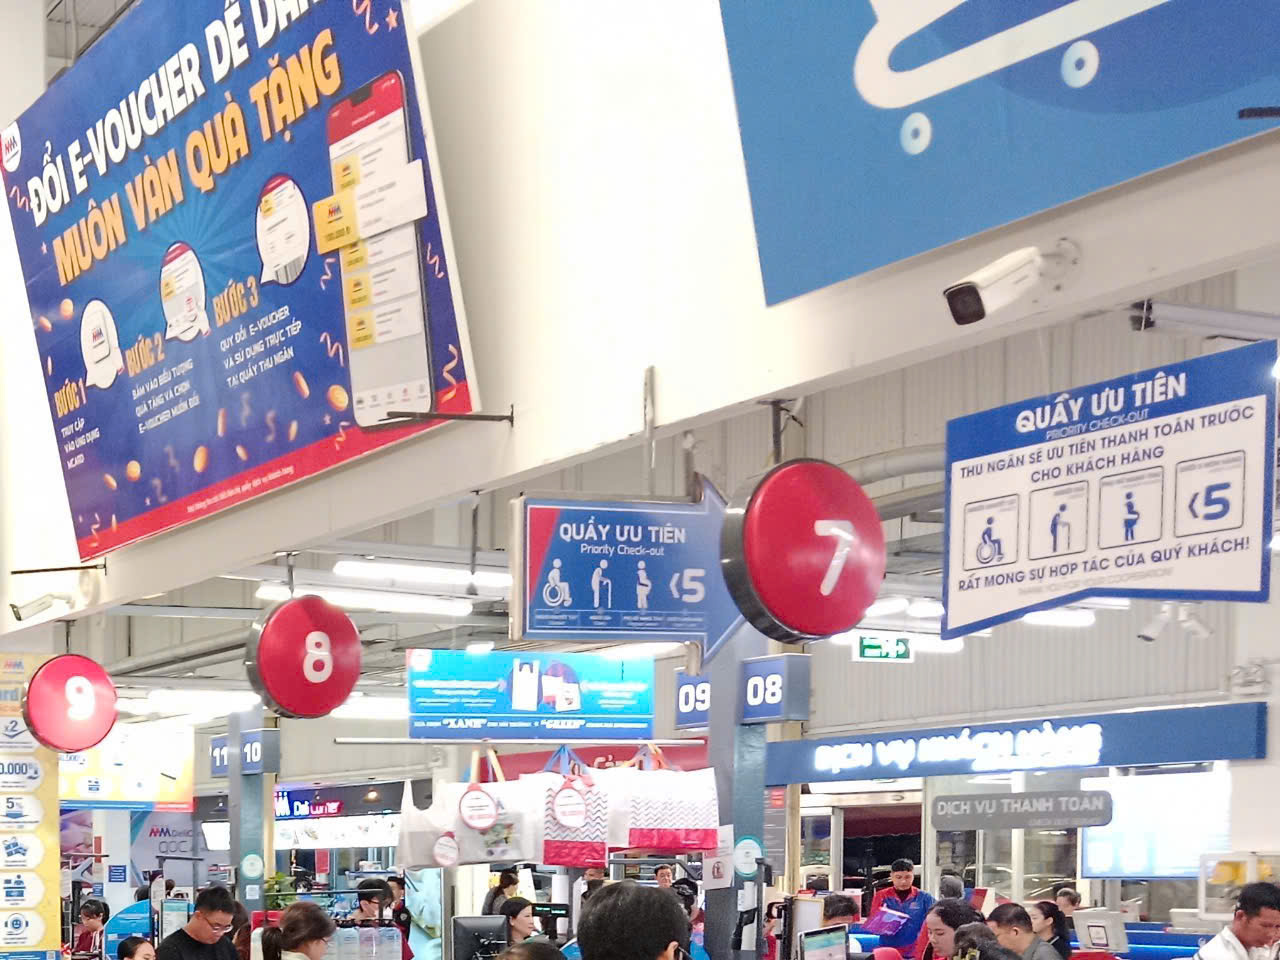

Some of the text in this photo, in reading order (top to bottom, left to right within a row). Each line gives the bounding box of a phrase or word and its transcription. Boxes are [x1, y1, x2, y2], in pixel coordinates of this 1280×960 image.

[27, 140, 70, 227] ĐỔI
[68, 43, 206, 195] E-VOUCHER
[52, 28, 342, 287] MUÔN VÀN QUÀ TẶNG
[247, 275, 259, 308] 3
[248, 305, 290, 336] E-VOUCHER
[154, 332, 166, 362] 2
[78, 378, 87, 405] 1
[1091, 387, 1125, 416] ƯU
[1132, 371, 1187, 407] TIÊN
[1046, 408, 1150, 440] PRIORITY CHECK-OUT
[960, 463, 983, 479] THU
[987, 453, 1024, 473] NGÂN
[1100, 428, 1149, 449] THANH
[1031, 467, 1061, 483] CHO
[1066, 454, 1116, 477] KHÁCH
[616, 524, 642, 542] ƯU
[648, 523, 686, 544] TIÊN
[580, 543, 665, 557] Priority Check-out
[814, 519, 855, 596] 7
[984, 571, 1025, 587] MONG
[1082, 556, 1110, 572] TÁC
[1187, 536, 1250, 559] KHÁCH!
[303, 631, 333, 683] 8
[65, 675, 97, 721] 9
[679, 682, 711, 713] 09
[747, 674, 783, 706] 08
[243, 741, 262, 763] 10
[937, 800, 970, 819] DỊCH
[976, 798, 996, 818] VỤ
[1000, 796, 1054, 813] THANH
